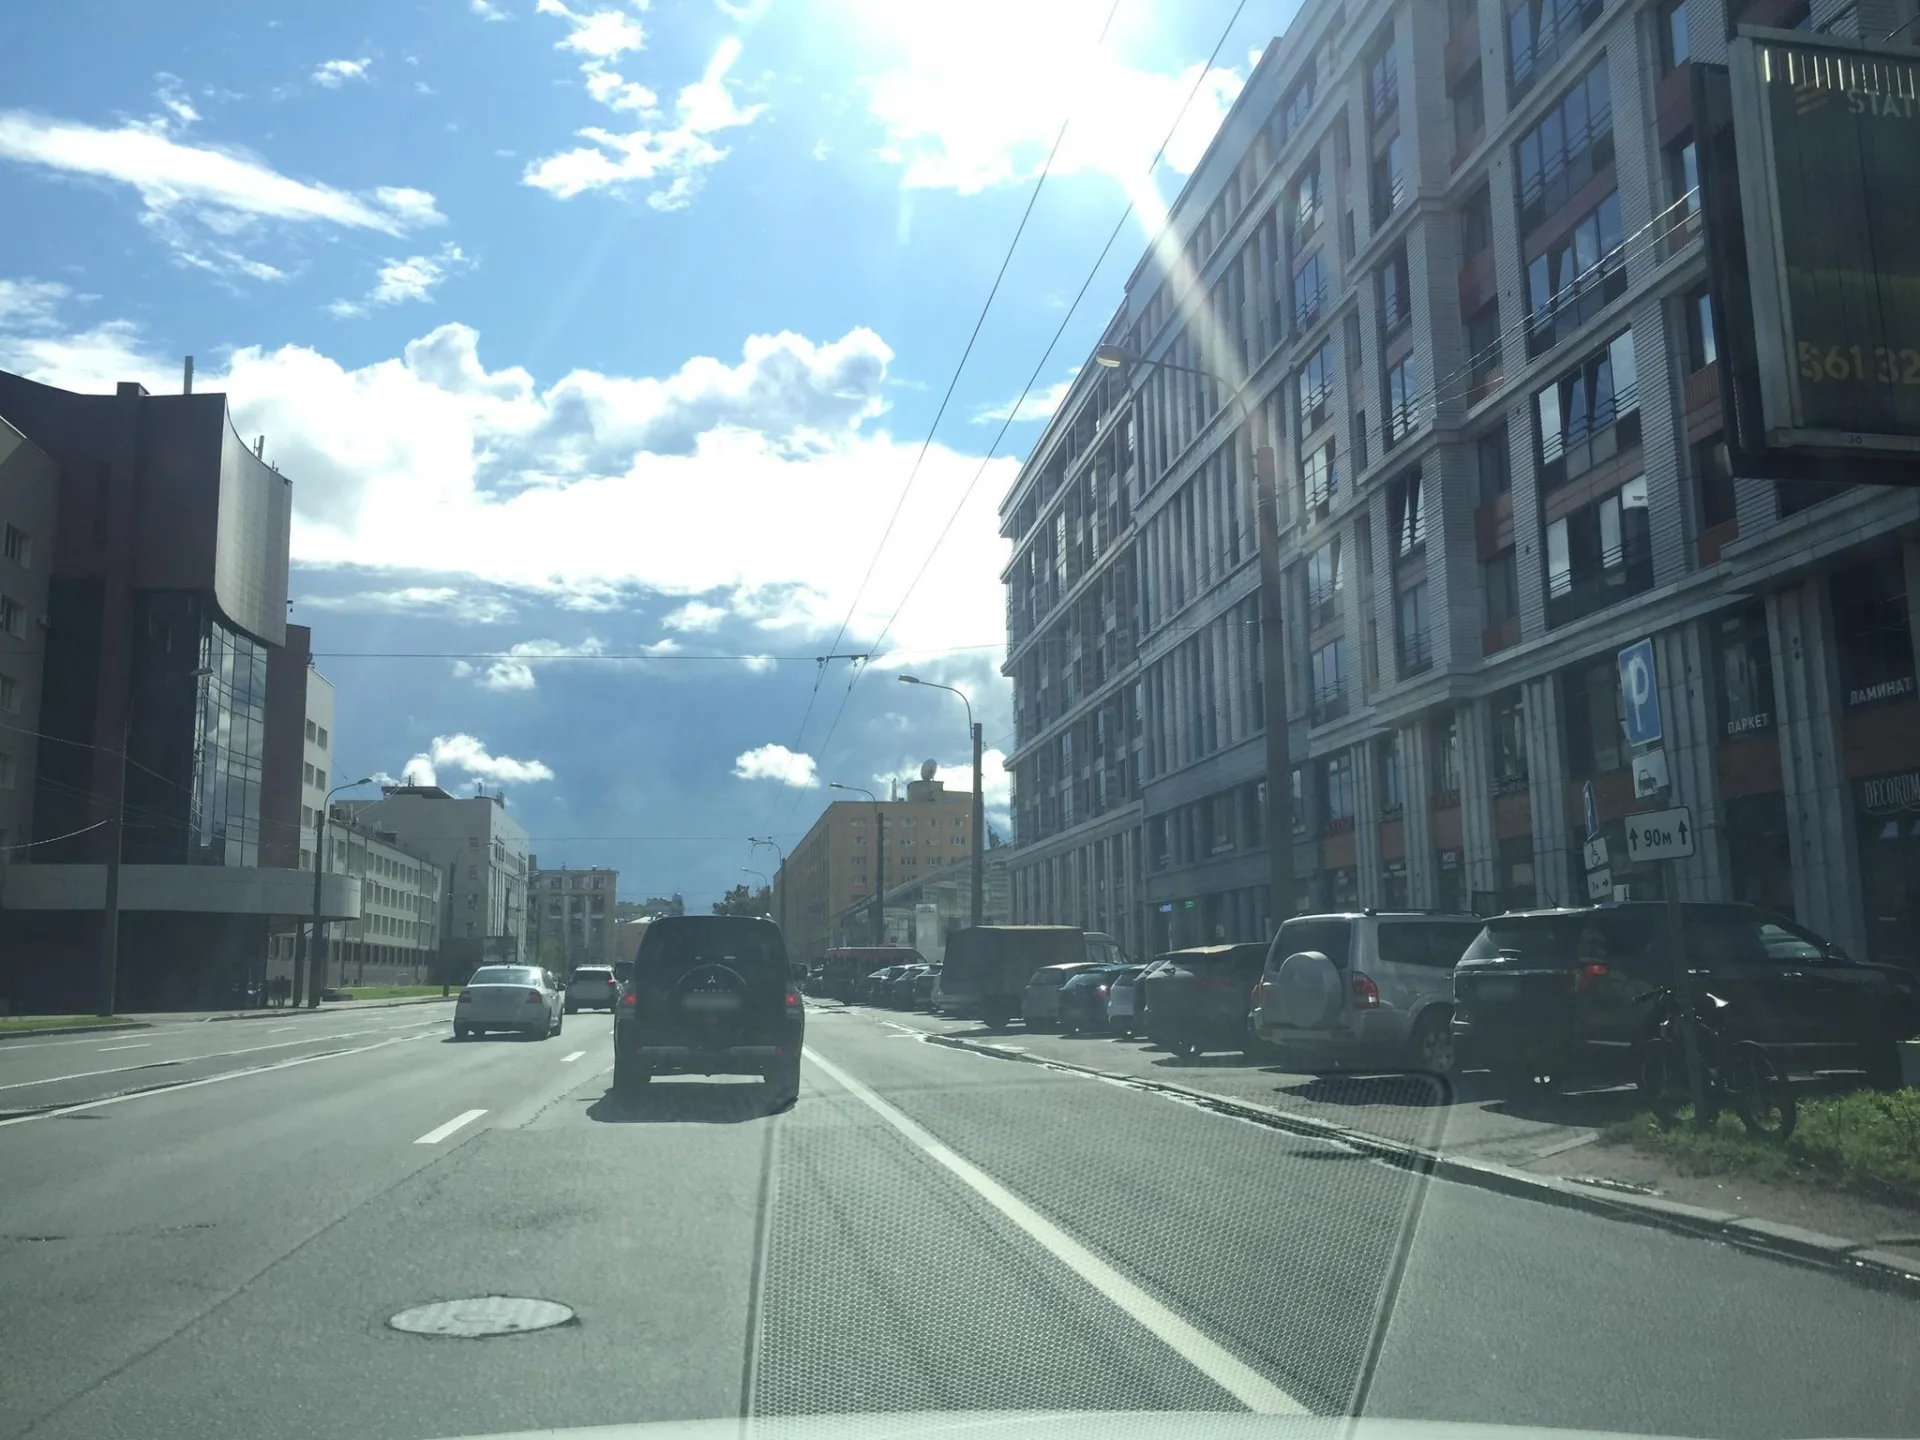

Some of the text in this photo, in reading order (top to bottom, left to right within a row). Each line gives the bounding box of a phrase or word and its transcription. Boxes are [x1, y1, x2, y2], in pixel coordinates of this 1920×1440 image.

[1846, 88, 1920, 118] STAT
[1628, 655, 1649, 732] P
[1850, 677, 1913, 706] ЛАМИНАТ
[1727, 712, 1770, 734] ПАРКЕТ
[1864, 772, 1920, 808] DECORUM
